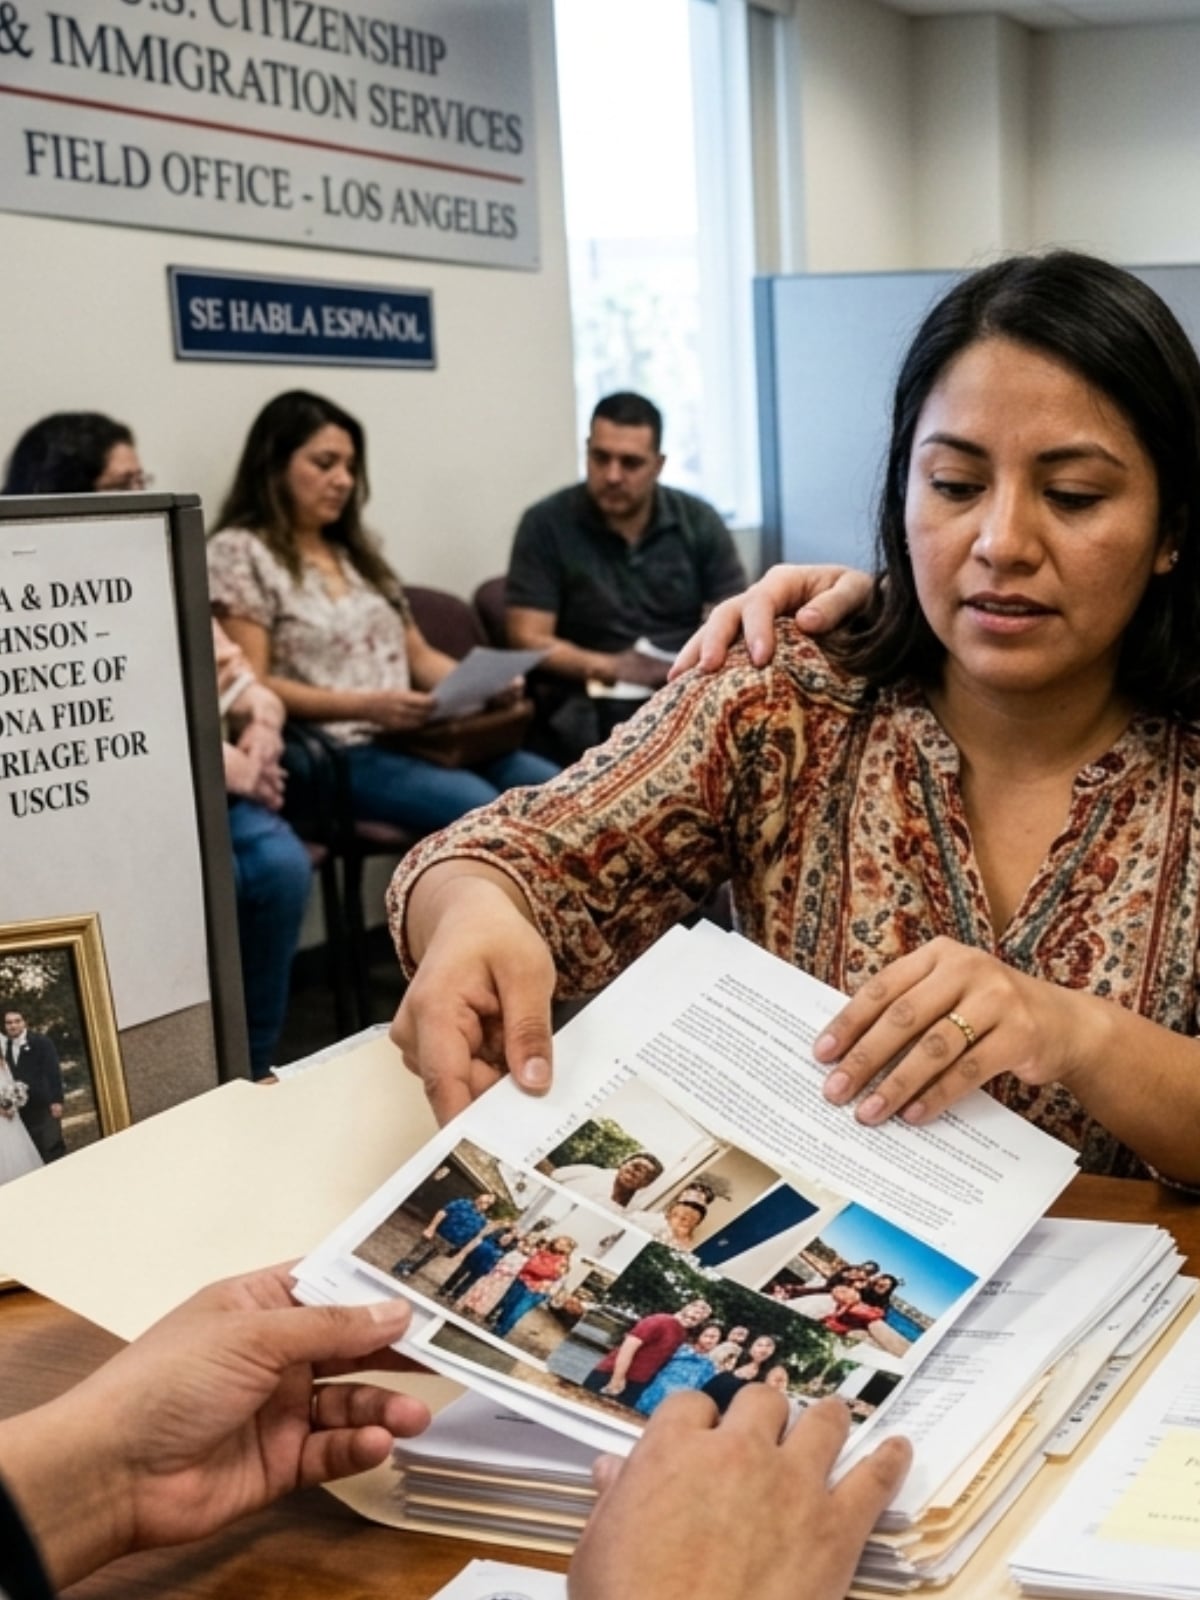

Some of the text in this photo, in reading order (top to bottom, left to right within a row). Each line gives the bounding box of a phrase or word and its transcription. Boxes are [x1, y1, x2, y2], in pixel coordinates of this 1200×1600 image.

[210, 0, 447, 76] CITIZENSHIP
[0, 1, 524, 155] & IMMIGRATION SERVICES
[24, 129, 151, 190] FIELD
[162, 151, 293, 209] OFFICE
[322, 175, 384, 222] LOS
[391, 189, 518, 240] ANGELES
[190, 297, 426, 343] SE HABLA ESPAÑOL
[20, 583, 41, 610] &
[49, 576, 132, 608] DAVID
[93, 654, 128, 684] OF
[0, 696, 115, 738] NA FIDE
[0, 730, 149, 780] RIAGE FOR
[8, 779, 91, 819] USCIS
